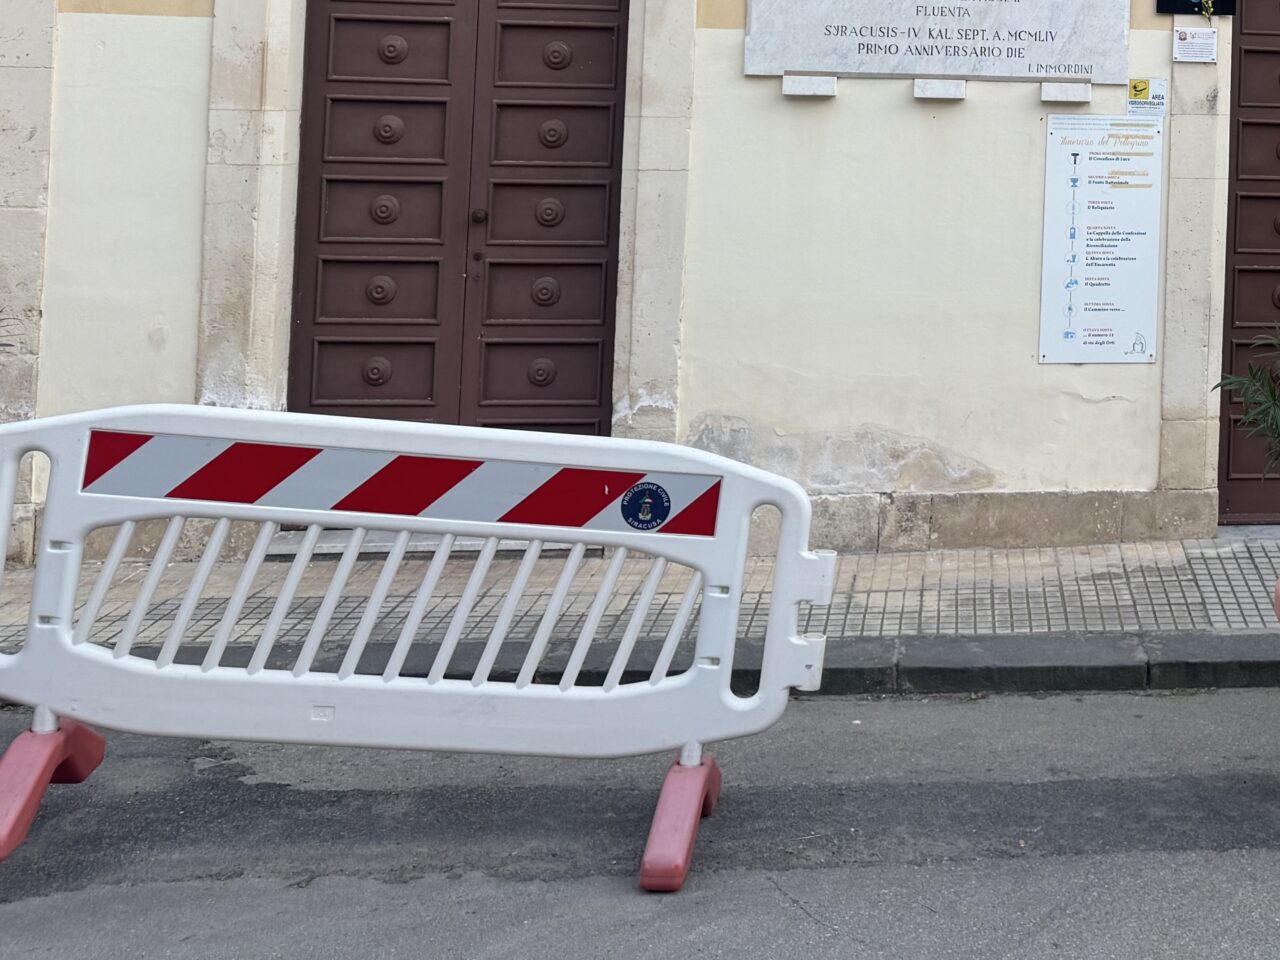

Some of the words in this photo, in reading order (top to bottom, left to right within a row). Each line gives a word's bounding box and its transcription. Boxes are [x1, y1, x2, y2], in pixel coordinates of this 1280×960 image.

[915, 5, 971, 18] FLUENTA
[928, 27, 954, 40] KAL.
[957, 28, 989, 41] SEPT.
[1007, 30, 1058, 42] MCMLIV
[857, 42, 899, 55] PRIMO
[904, 44, 1002, 58] ANNIVERSARIO
[1006, 47, 1025, 59] DIE
[1036, 63, 1093, 75] IMMORDINI
[623, 483, 658, 505] PROTEZIONE
[657, 488, 670, 507] CIVILE
[627, 517, 662, 529] SIRACUSA
